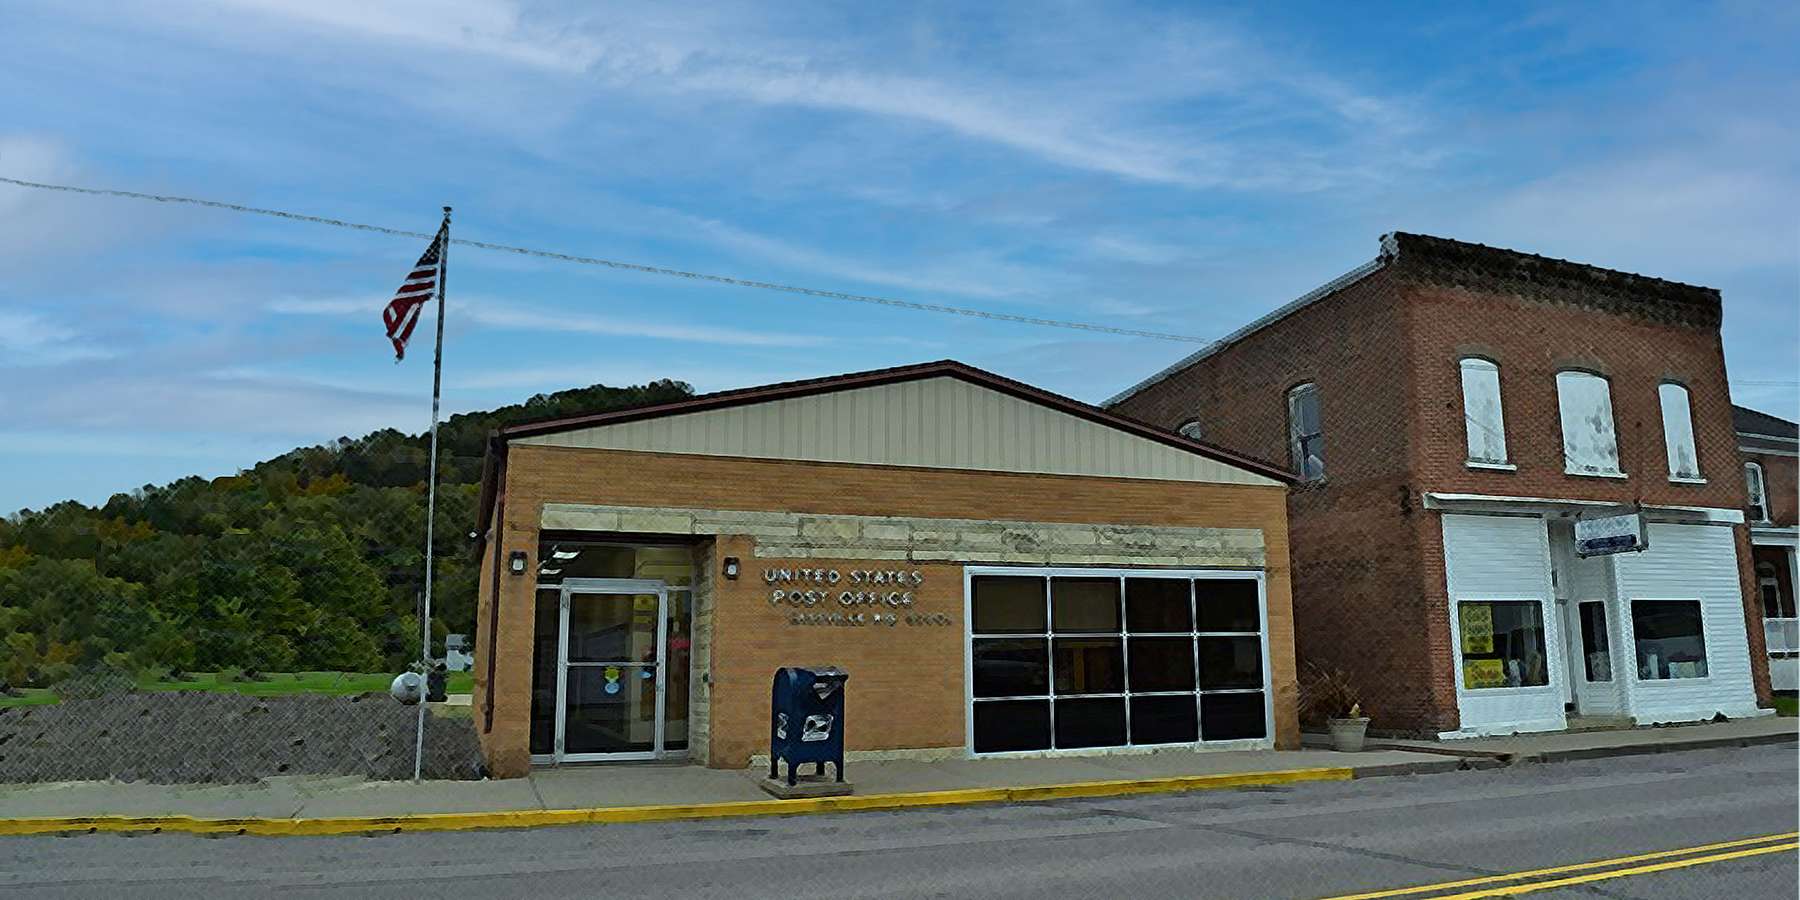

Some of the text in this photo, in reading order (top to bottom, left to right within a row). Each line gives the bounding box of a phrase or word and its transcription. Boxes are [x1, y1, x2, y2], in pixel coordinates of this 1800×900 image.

[764, 568, 923, 585] UNITED STATES
[772, 589, 914, 607] POST OFFICE
